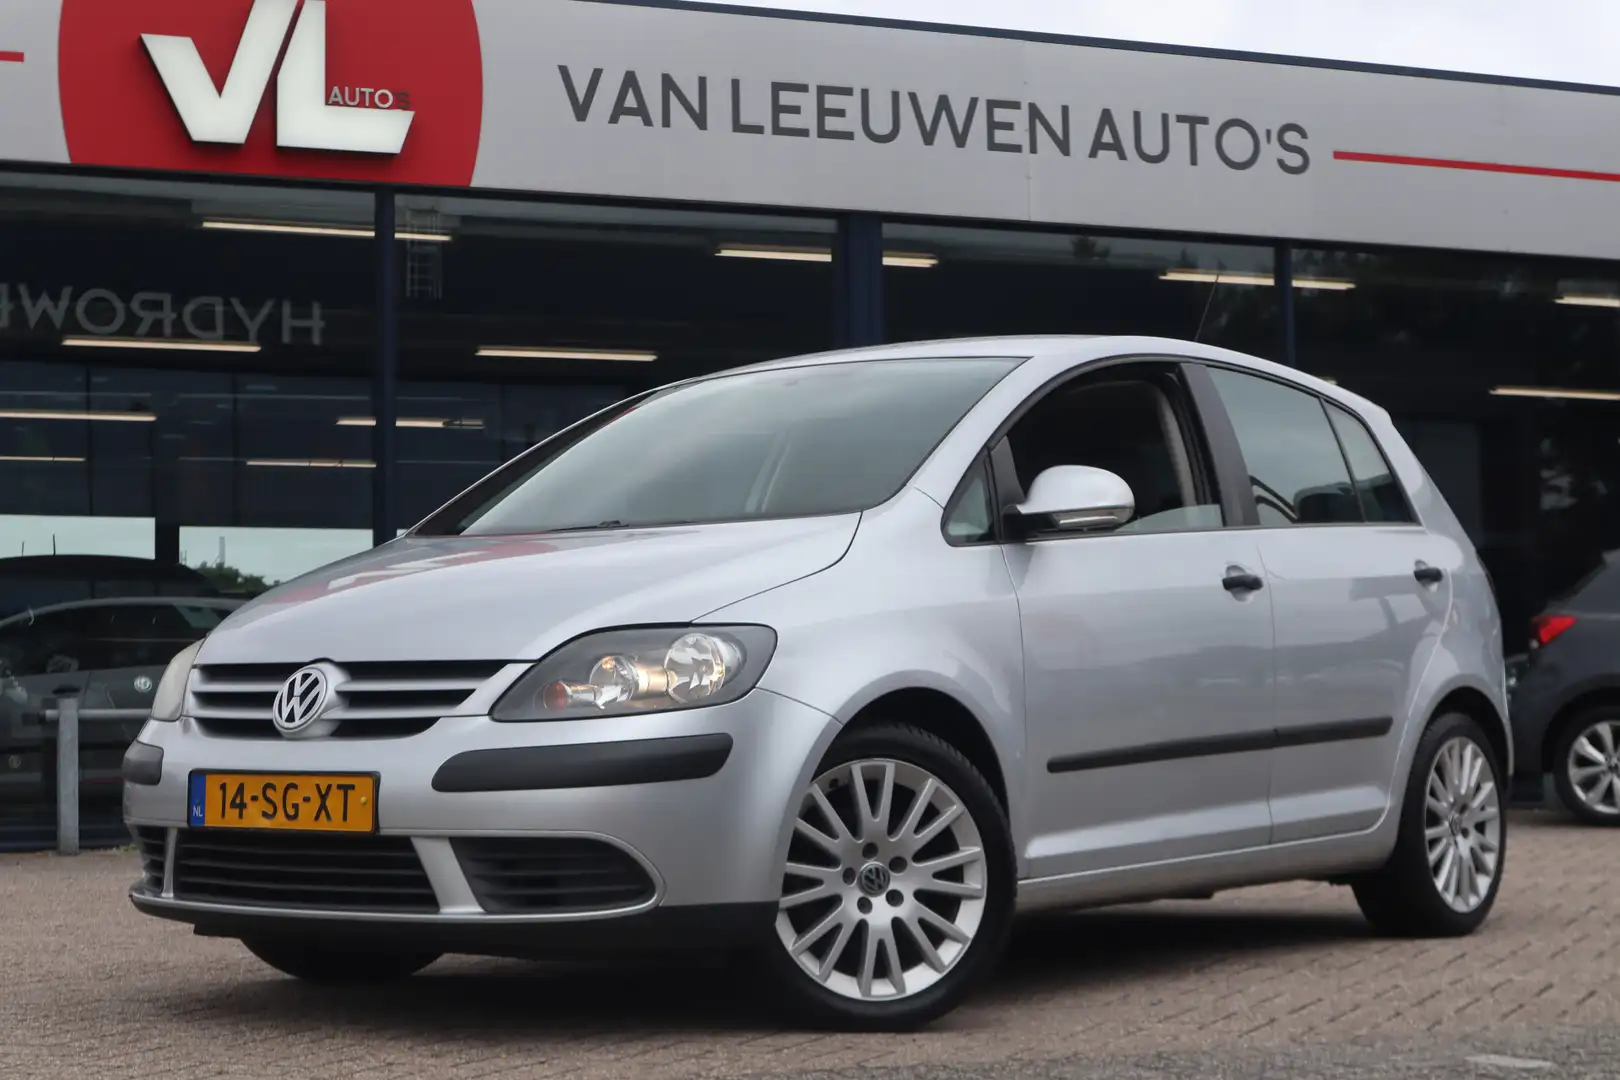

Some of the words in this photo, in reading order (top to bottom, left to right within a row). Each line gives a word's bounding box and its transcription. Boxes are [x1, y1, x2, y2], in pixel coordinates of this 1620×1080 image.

[557, 64, 708, 131] VAN
[731, 78, 1071, 157] LEEUWEN
[1088, 107, 1310, 175] AUTO'S
[192, 805, 203, 818] NL
[219, 782, 355, 822] 14-SG-XT
